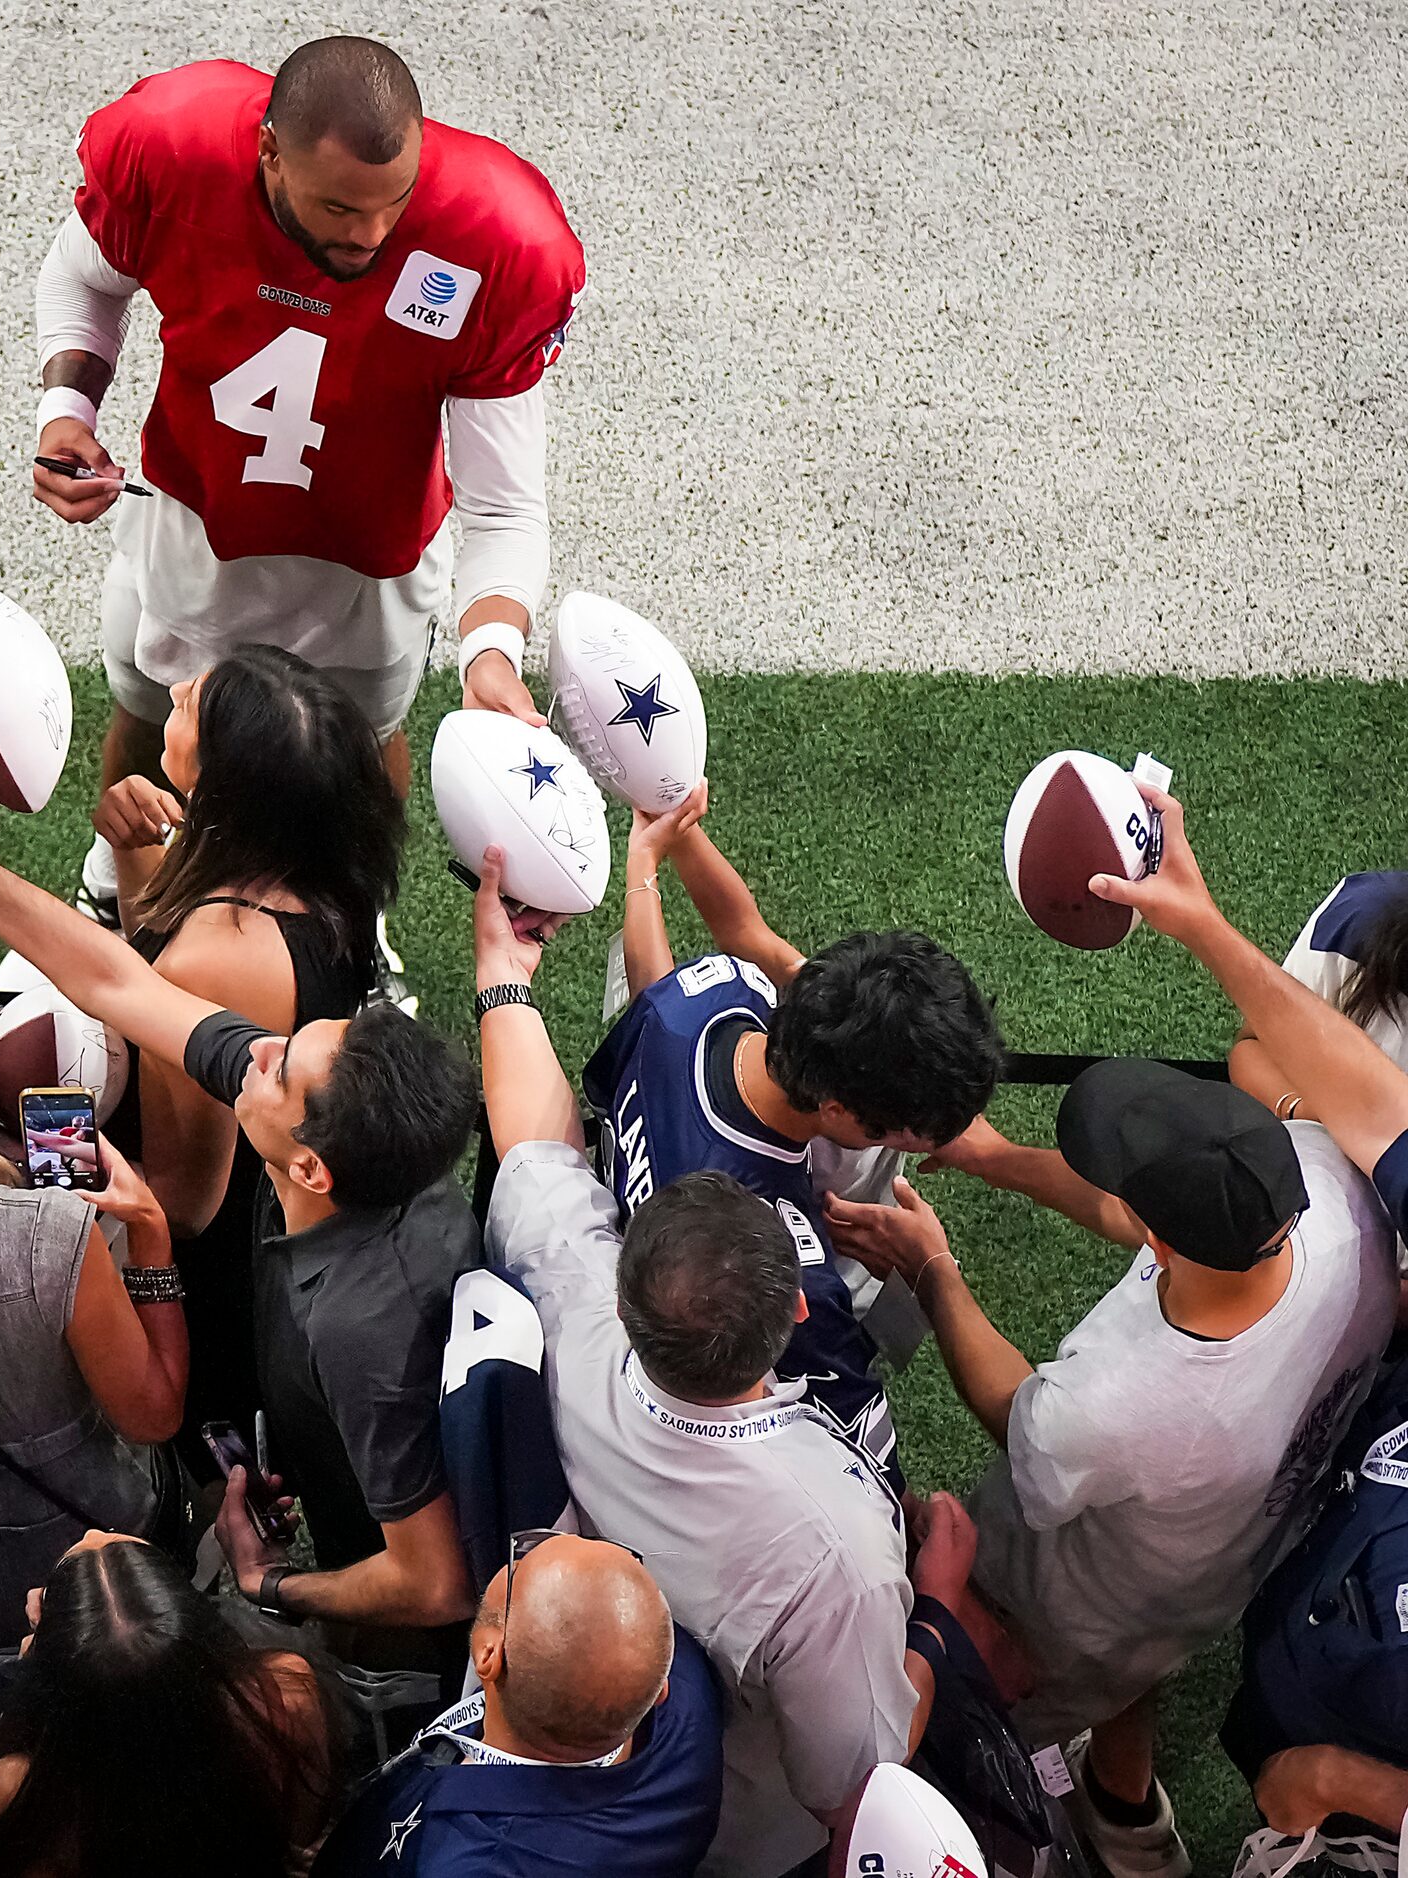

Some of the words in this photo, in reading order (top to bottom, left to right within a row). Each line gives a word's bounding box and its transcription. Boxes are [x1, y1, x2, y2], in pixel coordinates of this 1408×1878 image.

[257, 284, 332, 317] COWBOYS
[403, 303, 449, 328] AT&T
[210, 326, 327, 491] 4
[659, 1410, 727, 1439] COWBOYS
[729, 1417, 769, 1439] DALLAS
[857, 1852, 886, 1878] C
